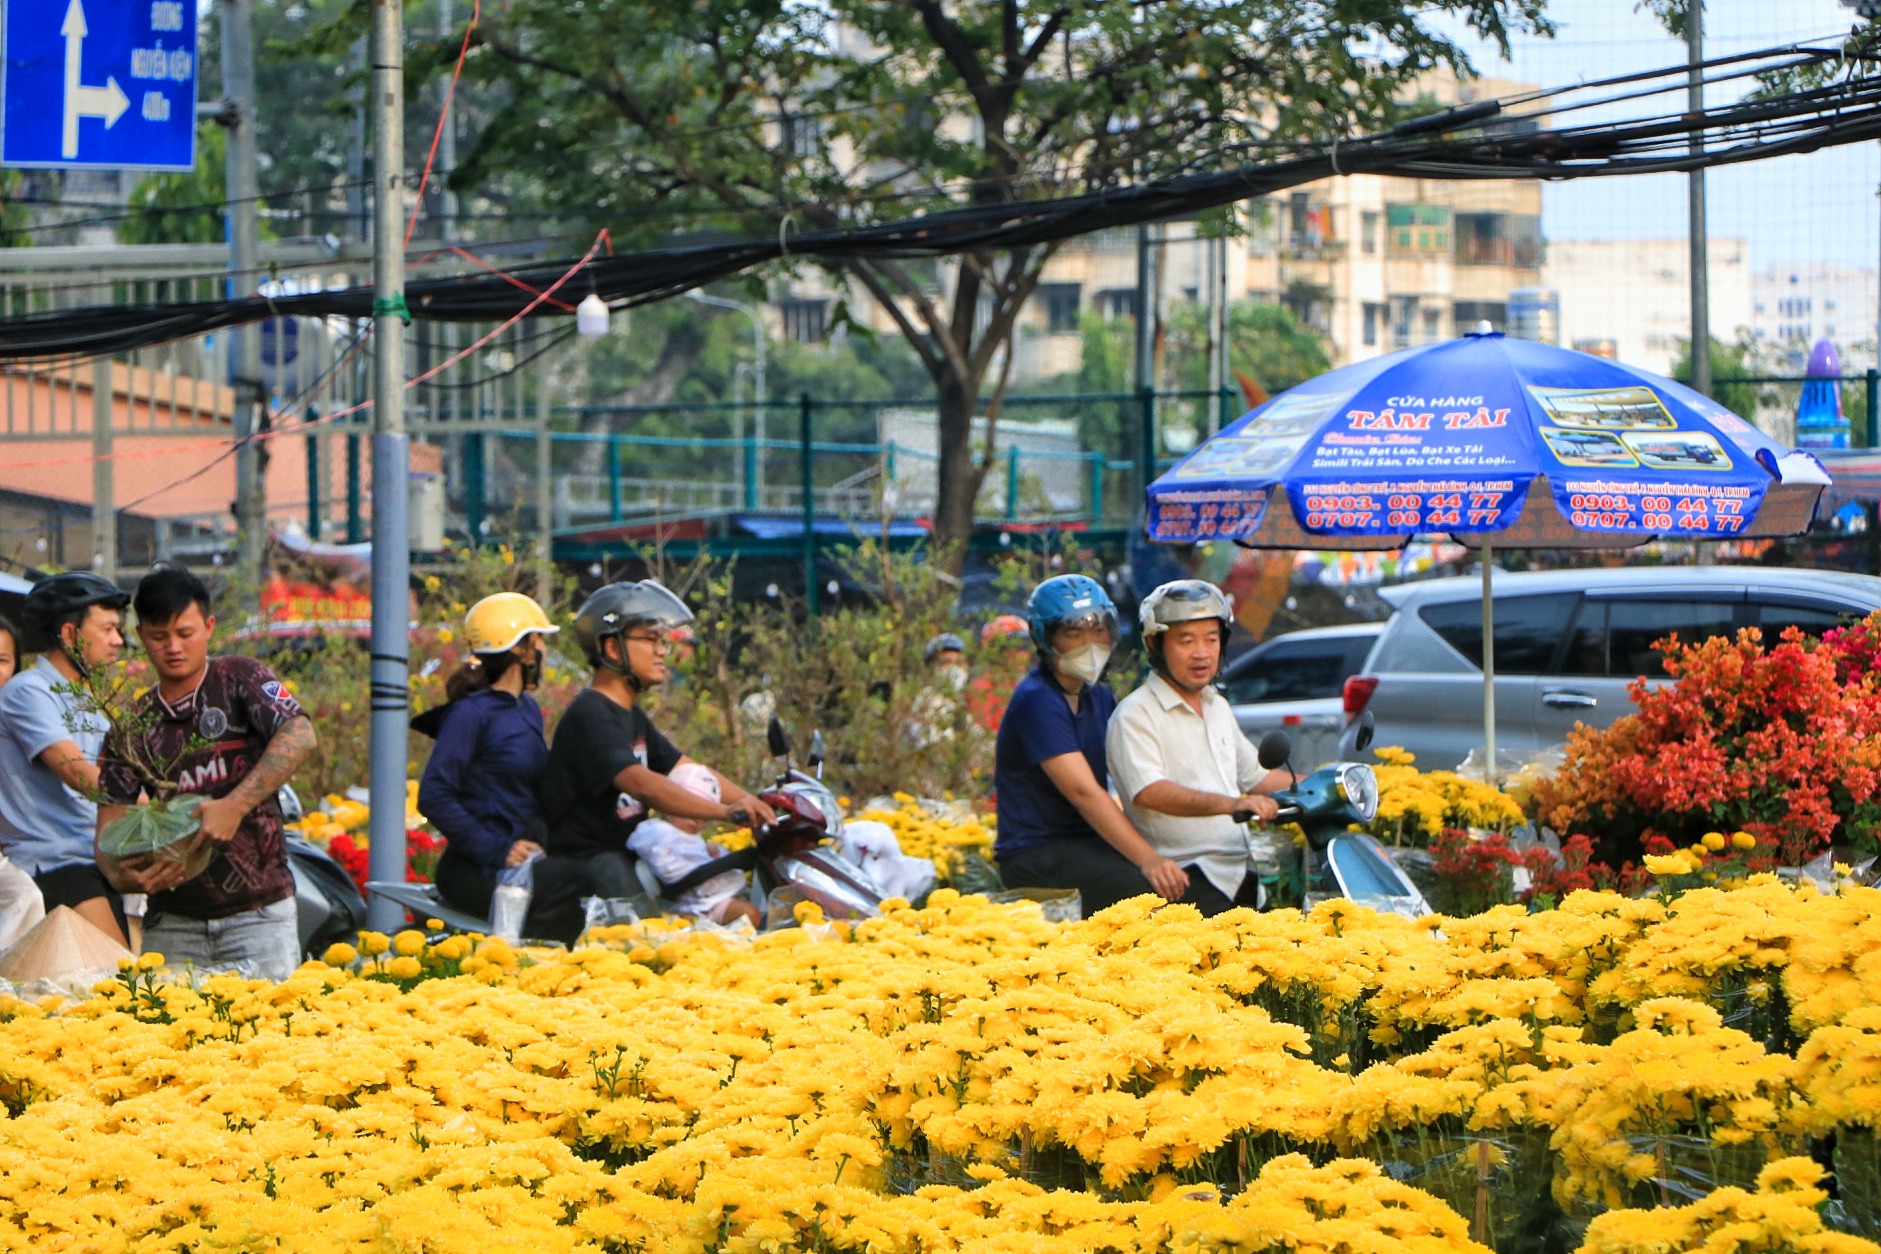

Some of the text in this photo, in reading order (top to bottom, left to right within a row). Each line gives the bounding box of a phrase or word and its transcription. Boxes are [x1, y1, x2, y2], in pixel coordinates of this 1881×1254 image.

[1387, 395, 1484, 408] CỬA HÀNG
[1316, 446, 1338, 457] Bạt
[1369, 446, 1391, 456] Bạt
[1421, 445, 1443, 456] Bạt
[1445, 446, 1462, 455] Xe
[1312, 458, 1348, 468] Simili
[1426, 456, 1454, 466] Che
[1456, 455, 1476, 465] Các
[1306, 493, 1503, 510] 0903. 00 44 77
[1571, 494, 1636, 511] 0903.
[1641, 496, 1670, 512] 00
[1676, 497, 1708, 513] 44
[1713, 499, 1743, 513] 77
[1306, 508, 1501, 527] 0707. 00 44 77
[1571, 511, 1636, 528] 0707.
[1643, 513, 1672, 529] 00
[1678, 514, 1709, 530] 44
[1715, 515, 1744, 531] 77
[157, 757, 229, 798] AMI
